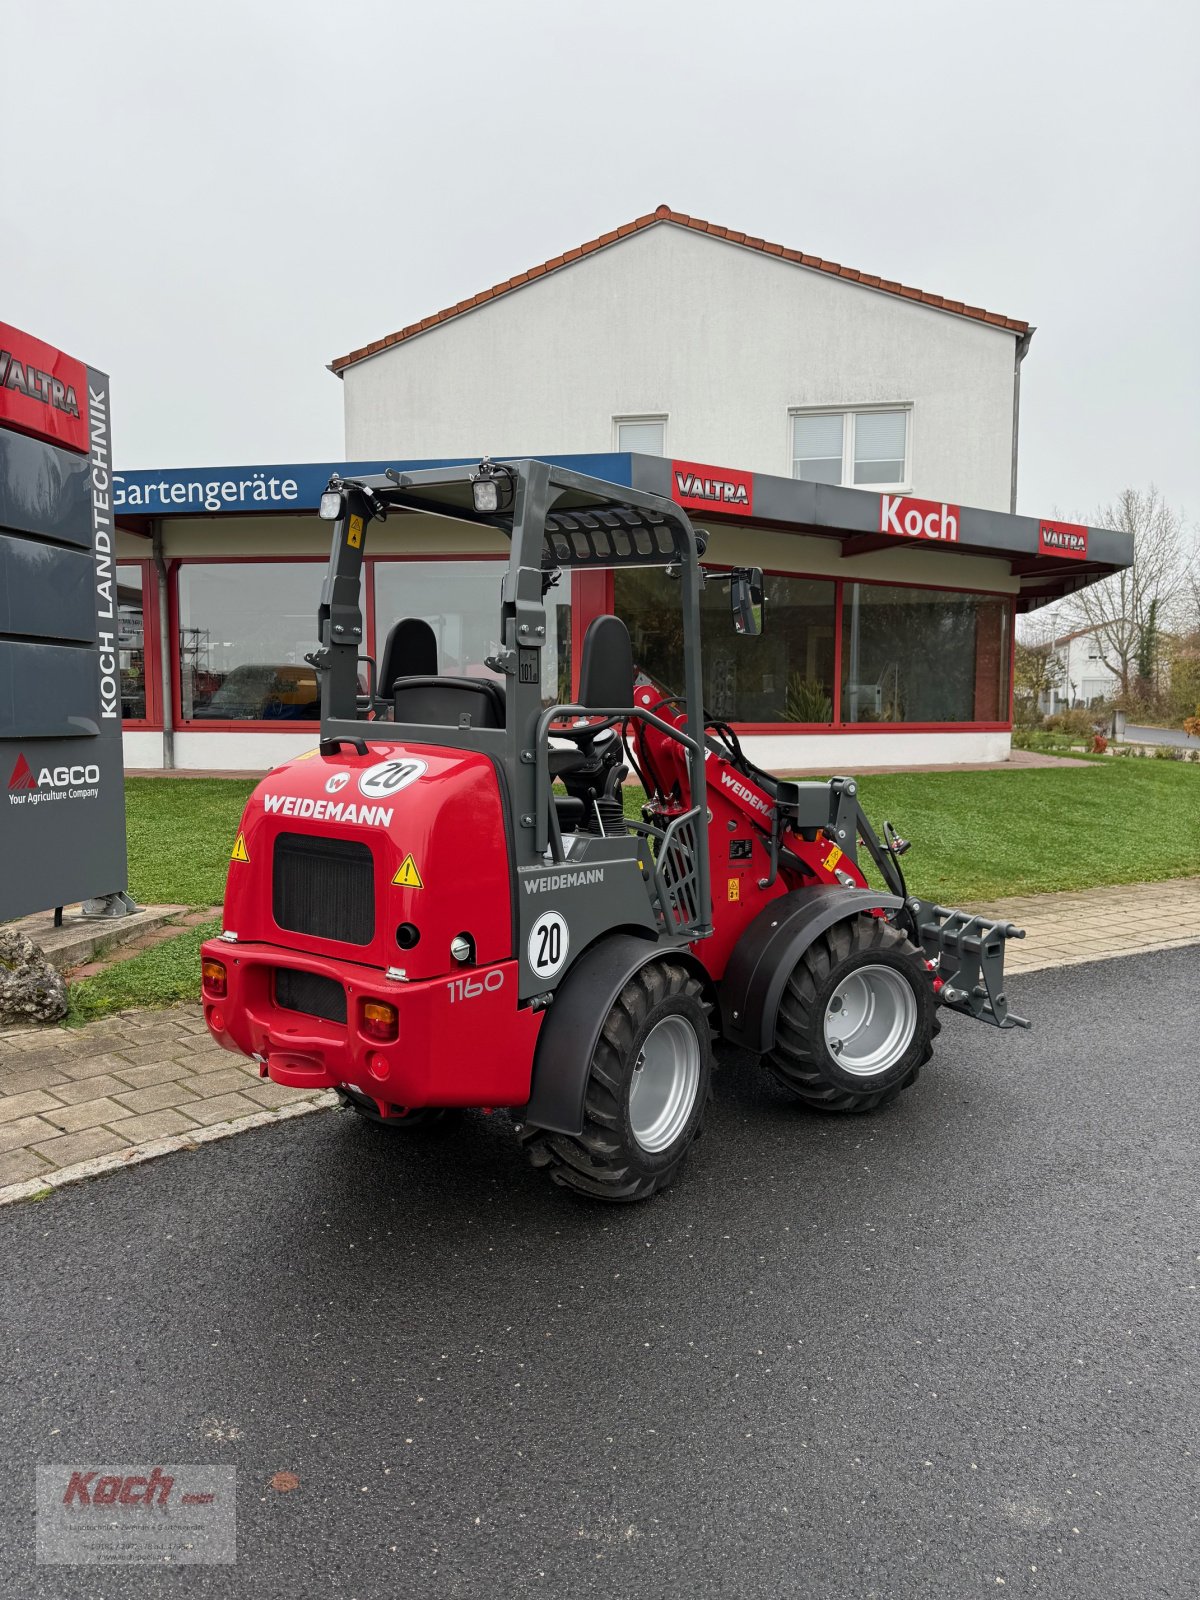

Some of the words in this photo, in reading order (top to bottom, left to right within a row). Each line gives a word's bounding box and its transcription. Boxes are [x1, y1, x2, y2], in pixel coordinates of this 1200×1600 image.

[89, 384, 114, 619] LANDTECHNIK
[112, 474, 298, 511] Gartengeräte
[675, 471, 749, 505] VALTRA
[881, 494, 957, 541] Koch
[1042, 527, 1086, 552] VALTRA
[98, 632, 117, 718] KOCH
[37, 765, 100, 787] AGCO
[364, 762, 418, 789] 20
[9, 794, 27, 805] Your
[27, 789, 67, 805] Agriculture
[68, 788, 99, 800] Company
[263, 794, 394, 827] WEIDEMANN
[524, 868, 604, 894] WEIDEMANN
[536, 922, 561, 968] 20
[447, 969, 505, 1003] 1160
